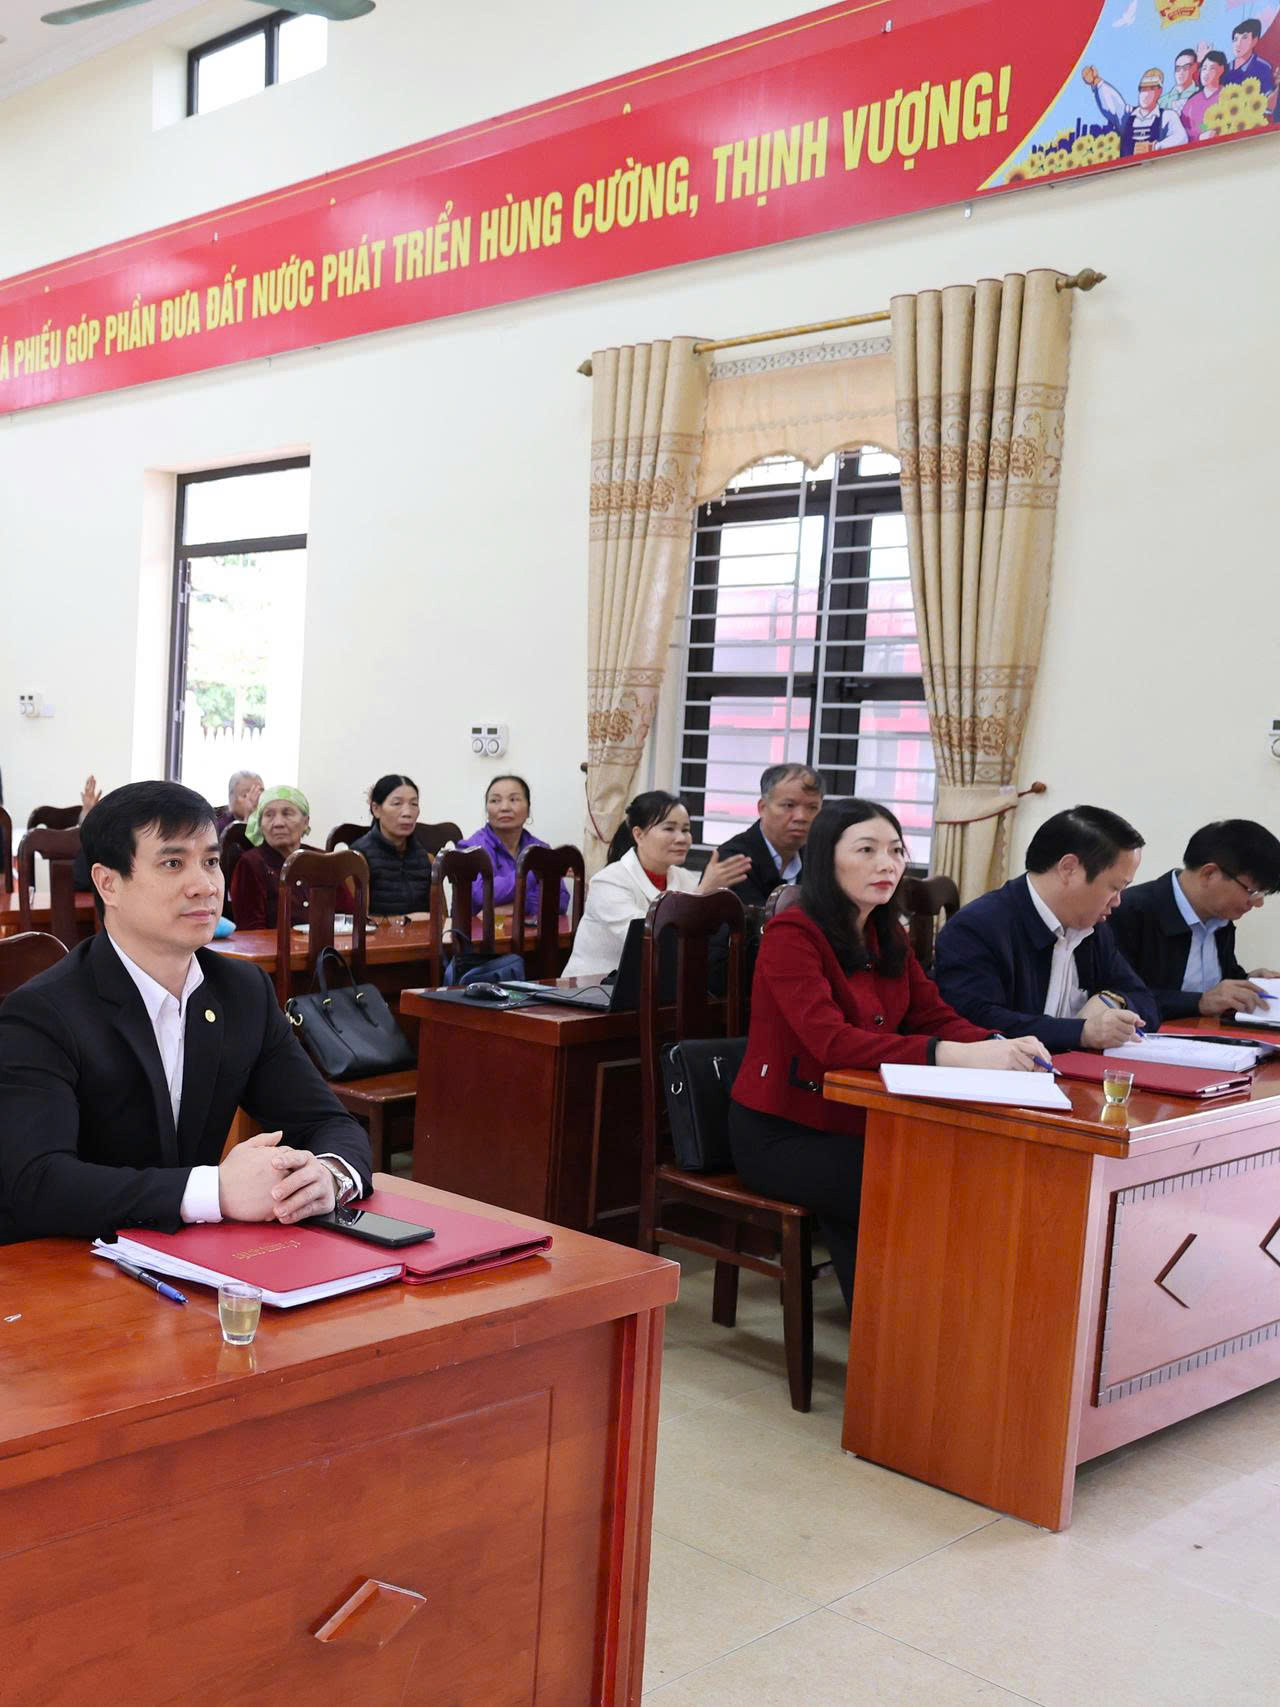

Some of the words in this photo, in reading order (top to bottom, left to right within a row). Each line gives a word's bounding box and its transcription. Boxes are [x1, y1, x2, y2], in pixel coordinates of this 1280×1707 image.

[13, 318, 62, 379] PHIẾU
[65, 312, 101, 366] GÓP
[104, 292, 156, 357] PHẦN
[160, 288, 201, 342] ĐƯA
[206, 263, 248, 331] ĐẤT
[252, 254, 316, 320] NƯỚC
[321, 233, 386, 303] PHÁT
[393, 199, 472, 284] TRIỂN
[479, 190, 563, 263] HÙNG
[571, 155, 700, 239] CƯỜNG,
[712, 116, 829, 208] THỊNH
[842, 64, 1013, 172] VƯỢNG!
